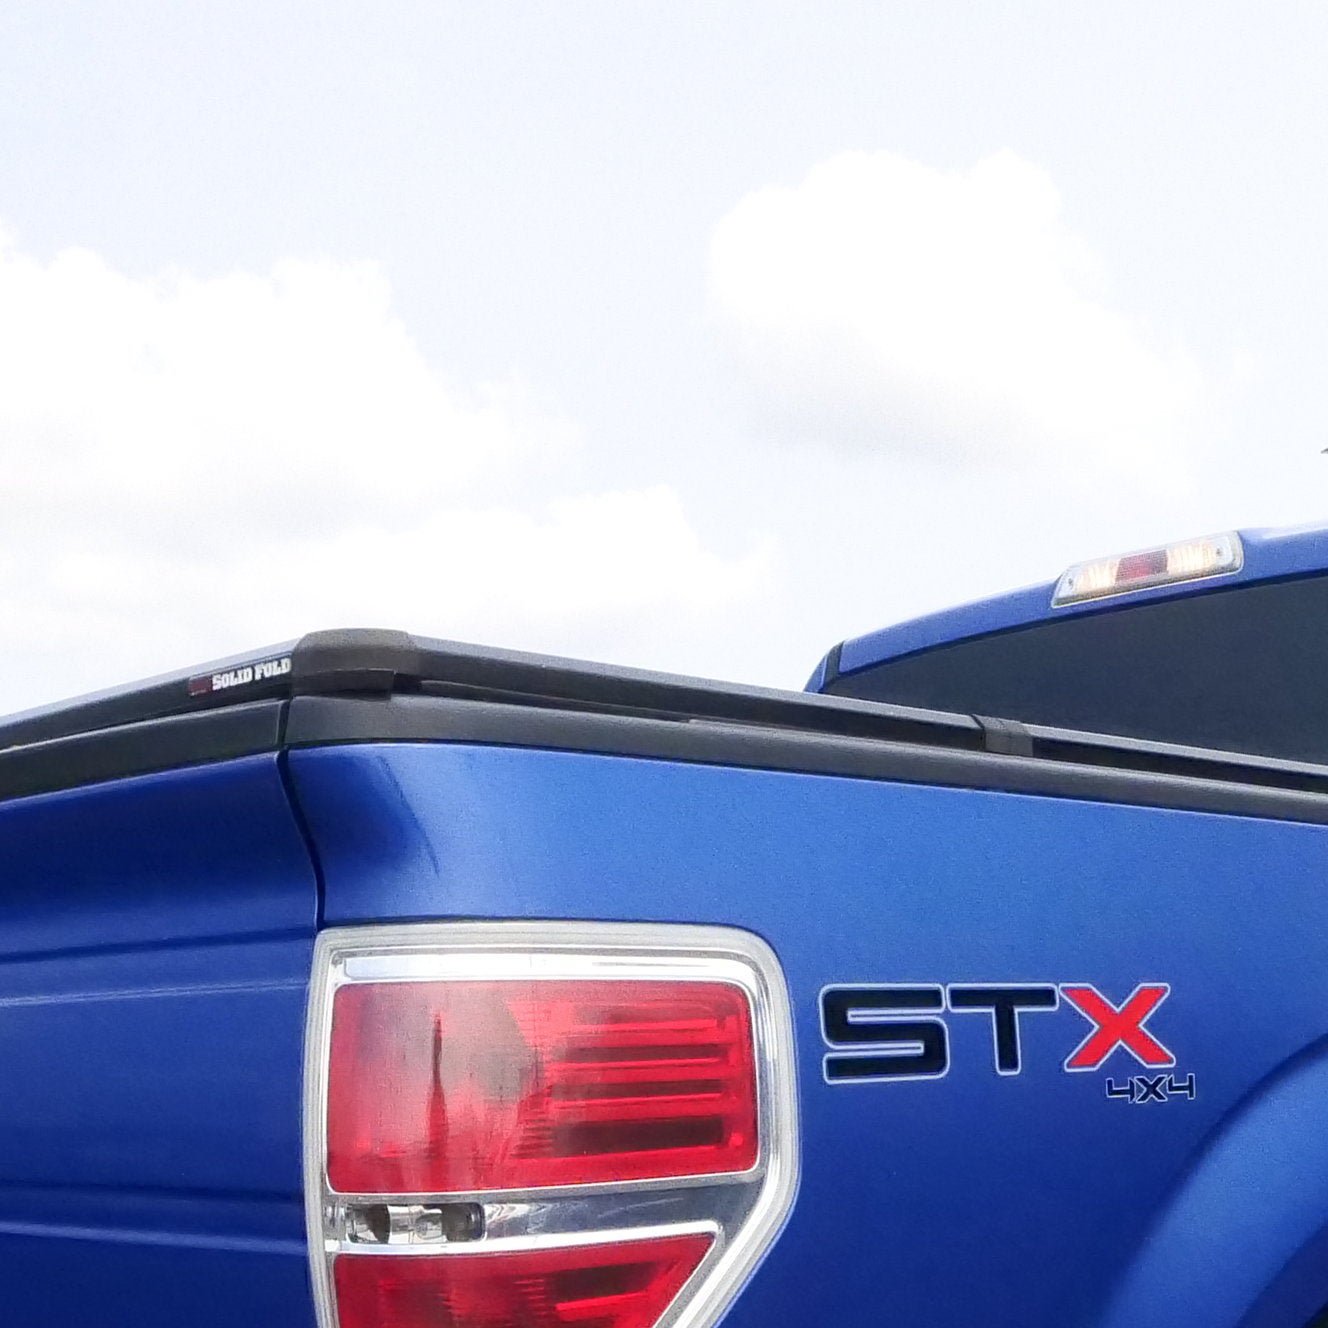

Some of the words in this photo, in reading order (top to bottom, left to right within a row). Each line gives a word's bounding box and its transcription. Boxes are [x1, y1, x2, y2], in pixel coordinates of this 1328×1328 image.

[212, 667, 253, 691] SOLID
[254, 658, 292, 680] FOLD
[819, 982, 1176, 1084] STX
